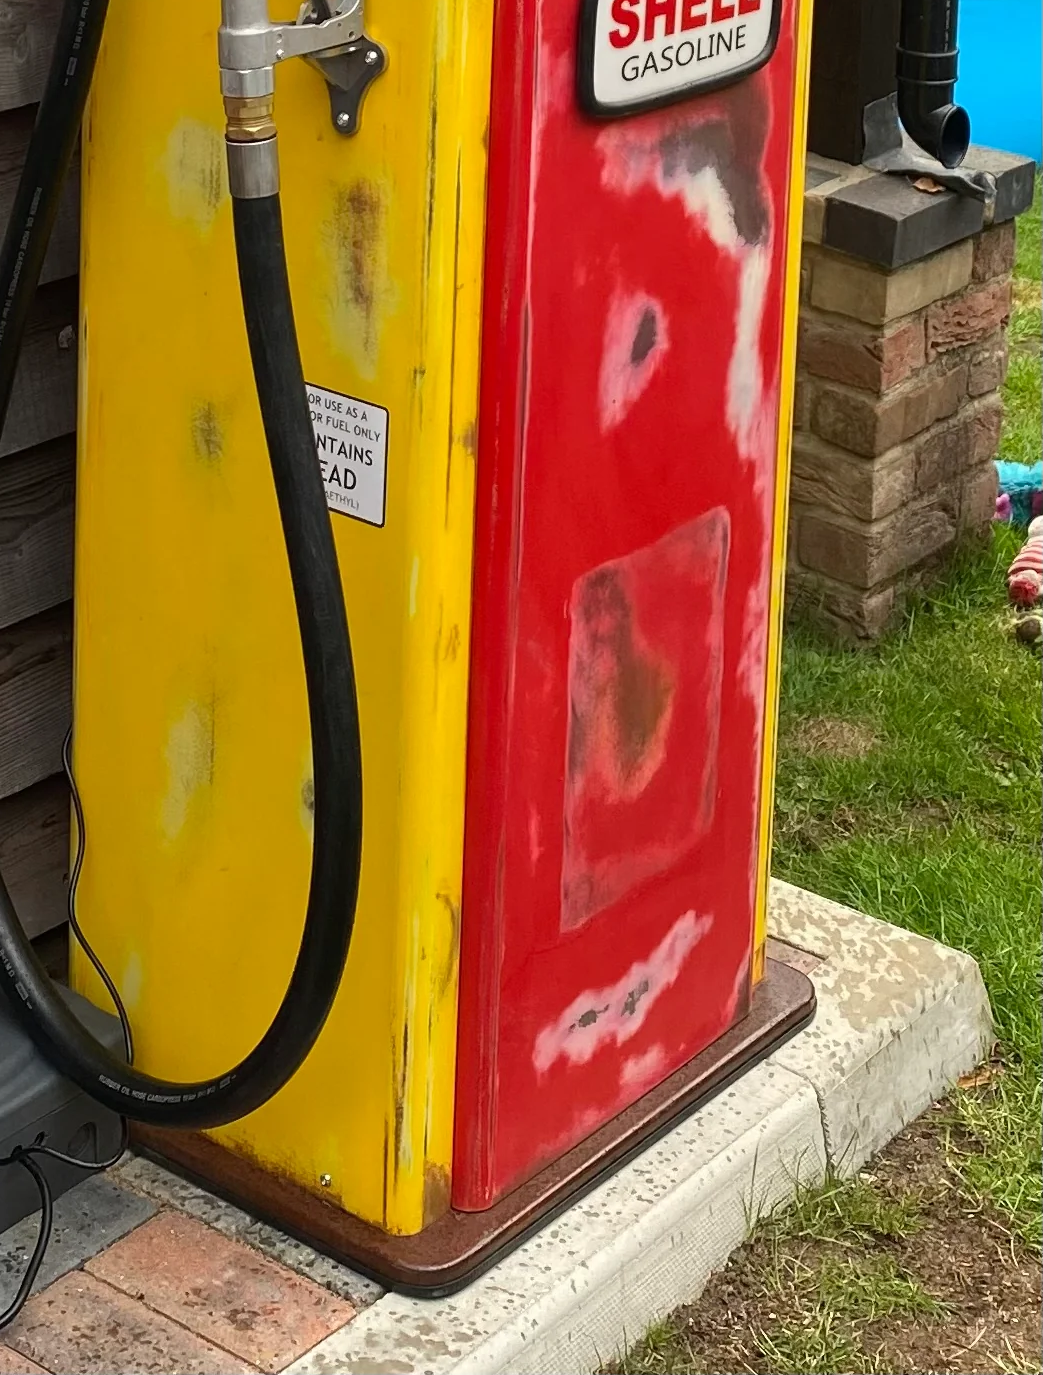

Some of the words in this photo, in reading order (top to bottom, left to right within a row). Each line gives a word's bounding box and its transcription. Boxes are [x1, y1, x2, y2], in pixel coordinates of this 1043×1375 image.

[621, 24, 746, 81] GASOLINE
[307, 393, 321, 407] OR
[324, 400, 342, 414] USE
[346, 406, 358, 418] AS
[360, 411, 368, 422] A
[310, 410, 323, 423] OR
[326, 416, 351, 433] FUEL
[353, 425, 381, 442] ONLY
[316, 432, 373, 467] NTAINS
[320, 460, 356, 490] EAD
